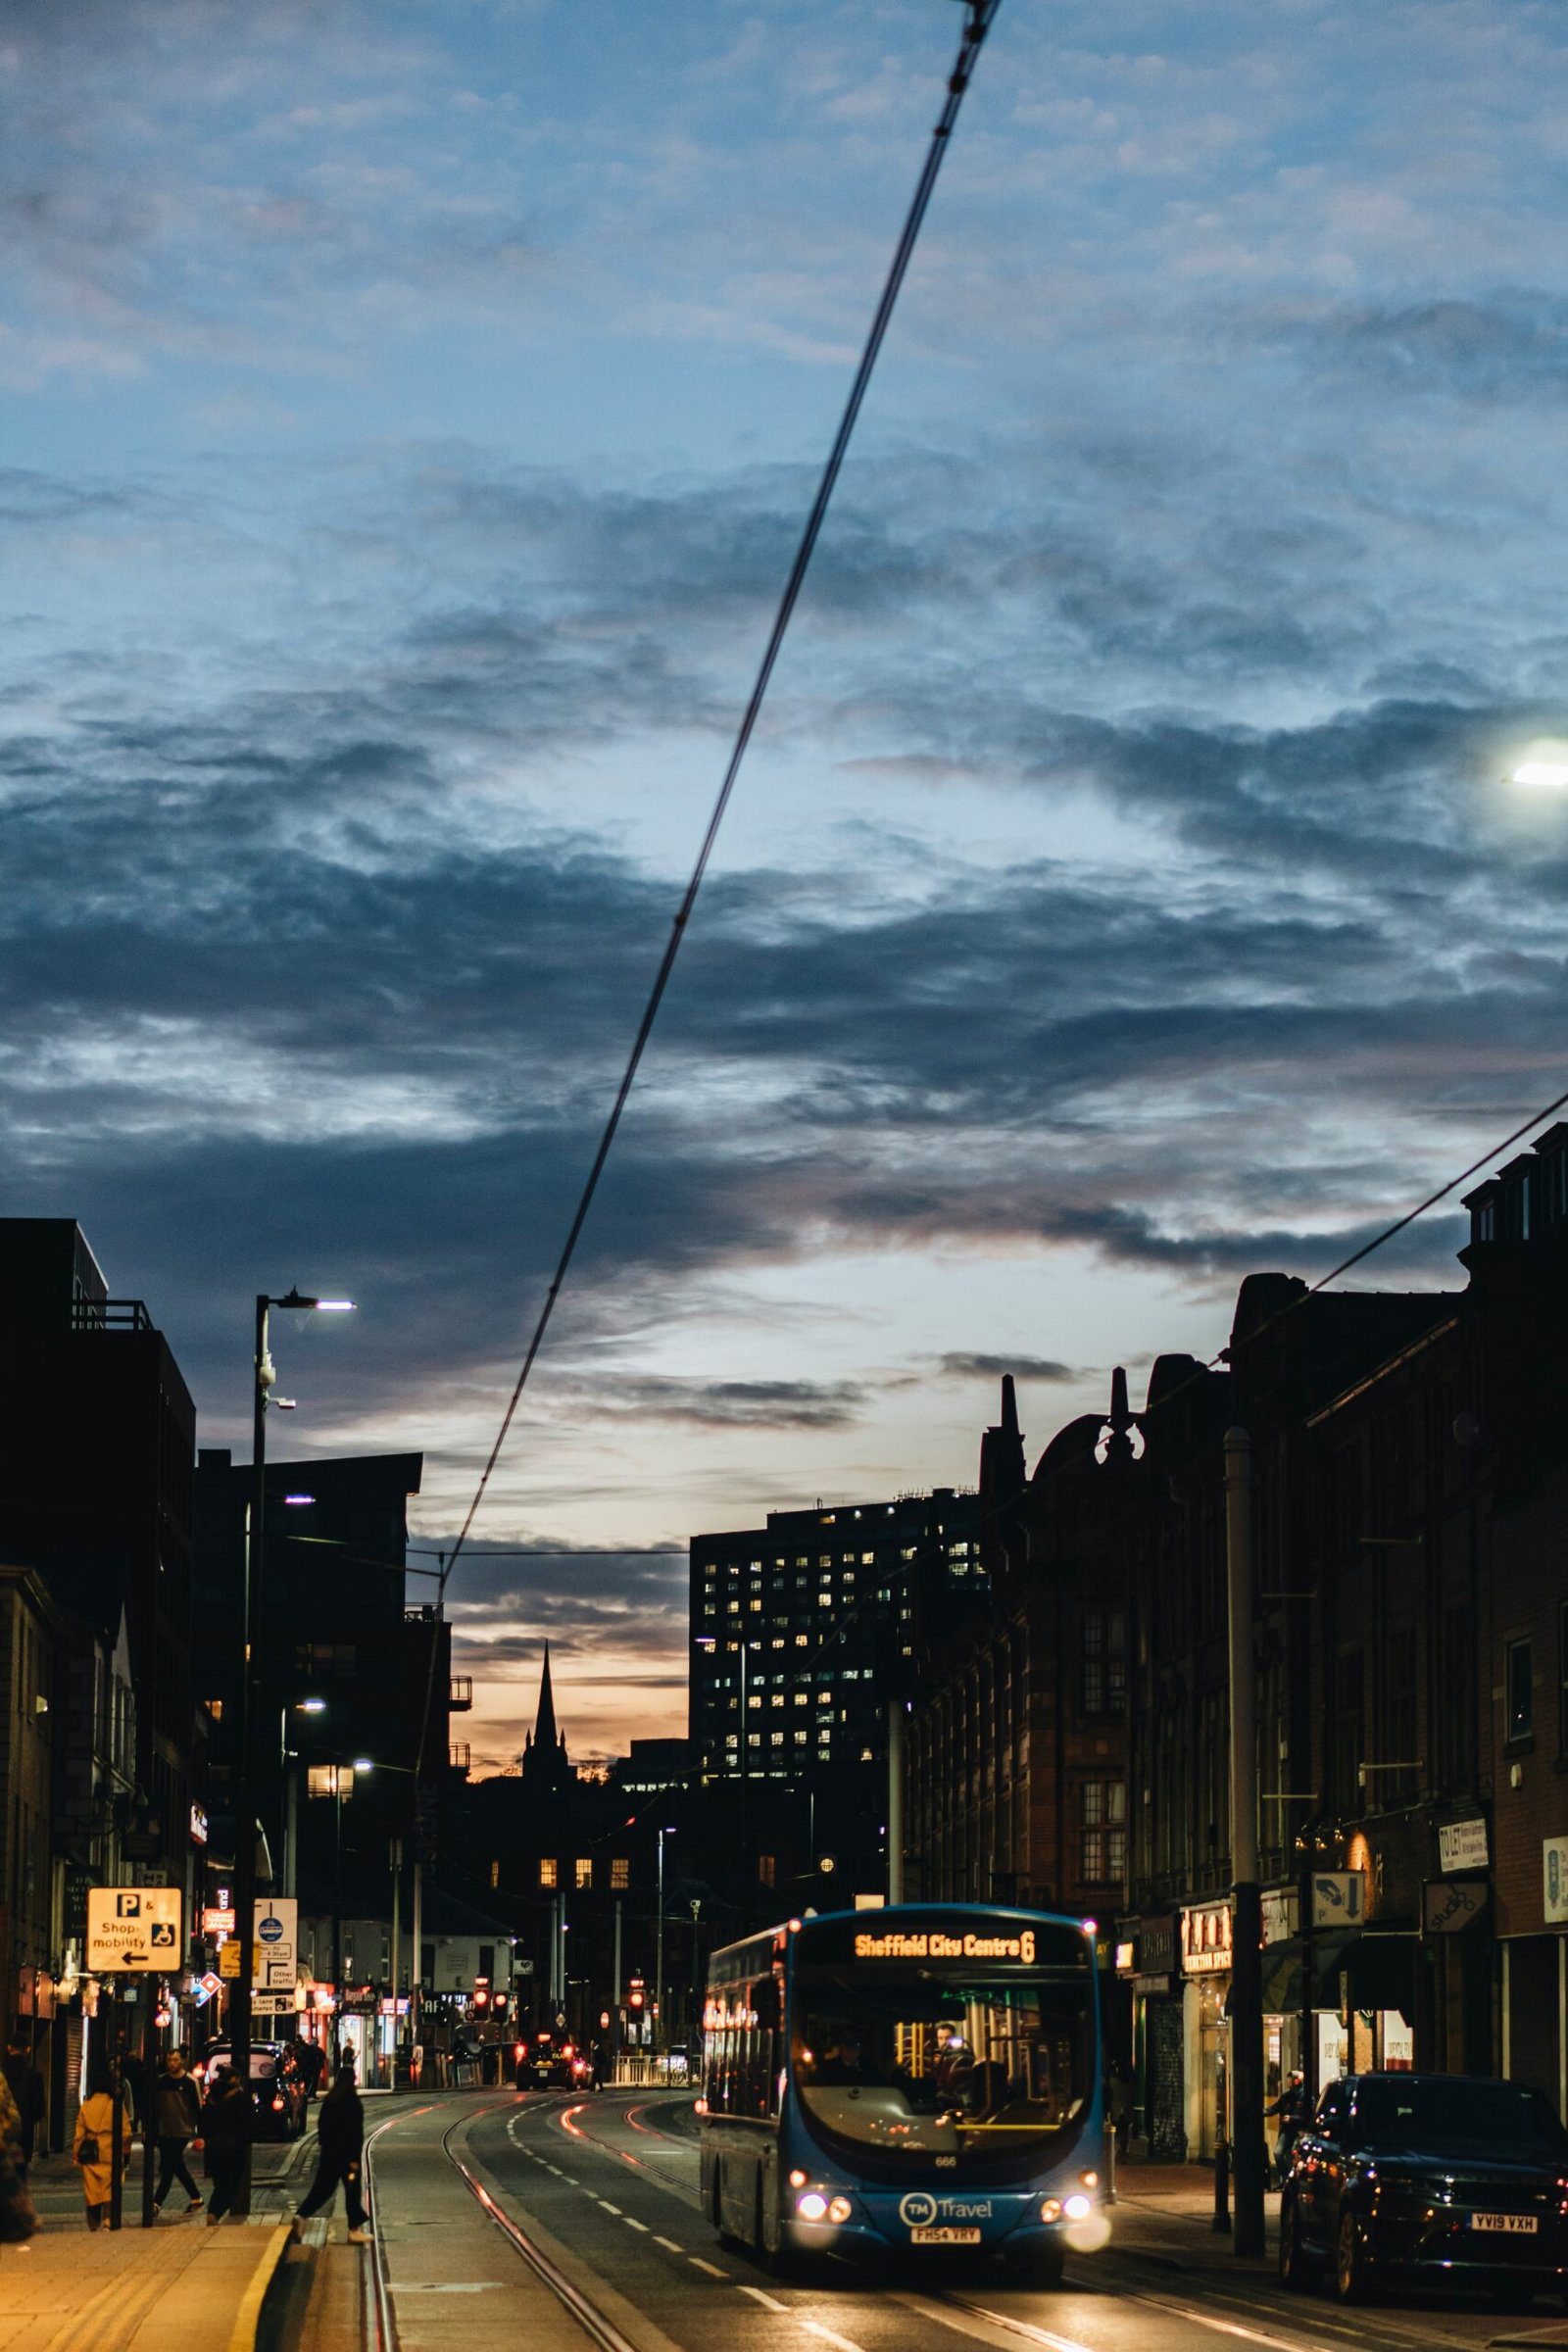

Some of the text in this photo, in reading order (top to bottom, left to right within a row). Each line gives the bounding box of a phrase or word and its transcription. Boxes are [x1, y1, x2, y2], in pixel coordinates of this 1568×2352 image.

[93, 1937, 146, 1949] mobility
[855, 1931, 1035, 1964] Sheffield City Centre 6
[935, 2156, 956, 2167] 666
[907, 2198, 992, 2218] TM Travel
[1476, 2215, 1534, 2230] YV19 VXH
[916, 2229, 949, 2241] FH54
